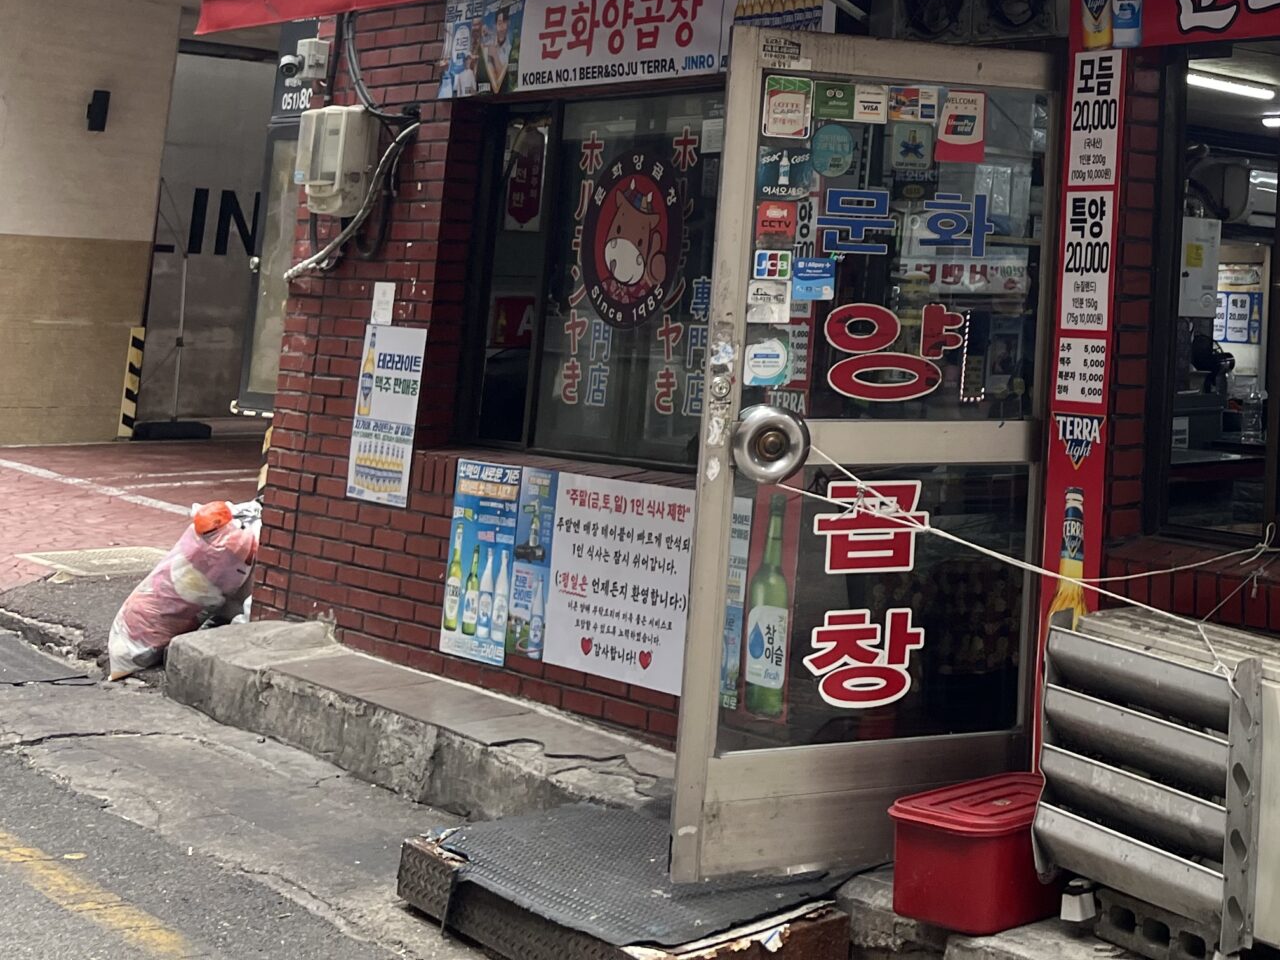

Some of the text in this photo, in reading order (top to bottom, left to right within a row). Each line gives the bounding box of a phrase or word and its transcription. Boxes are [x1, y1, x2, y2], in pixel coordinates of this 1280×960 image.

[522, 70, 554, 86] KOREA
[555, 67, 577, 83] NO.1
[579, 61, 638, 81] BEER&SOJU
[681, 54, 715, 72] JINRO
[1077, 55, 1114, 96] 모듬
[862, 104, 879, 112] VISA
[944, 96, 978, 106] WELCOME
[1072, 98, 1118, 134] 20,000
[761, 219, 792, 229] CCTV
[1069, 196, 1106, 239] 특양
[756, 258, 789, 273] JCB
[1064, 241, 1110, 277] 20,000
[632, 283, 664, 321] 1985
[1083, 344, 1106, 355] 5,000
[376, 351, 422, 374] 테라라이트
[1083, 358, 1105, 369] 5,000
[374, 375, 420, 397] 맥주 판매중
[1078, 372, 1104, 383] 15,000
[1080, 386, 1103, 398] 6,000
[1055, 415, 1101, 444] TERRA
[1065, 439, 1092, 461] Light
[630, 498, 666, 520] 1인 식사
[586, 544, 611, 564] 식사는
[591, 577, 629, 601] 언제든지
[593, 642, 637, 666] 감사합니다!
